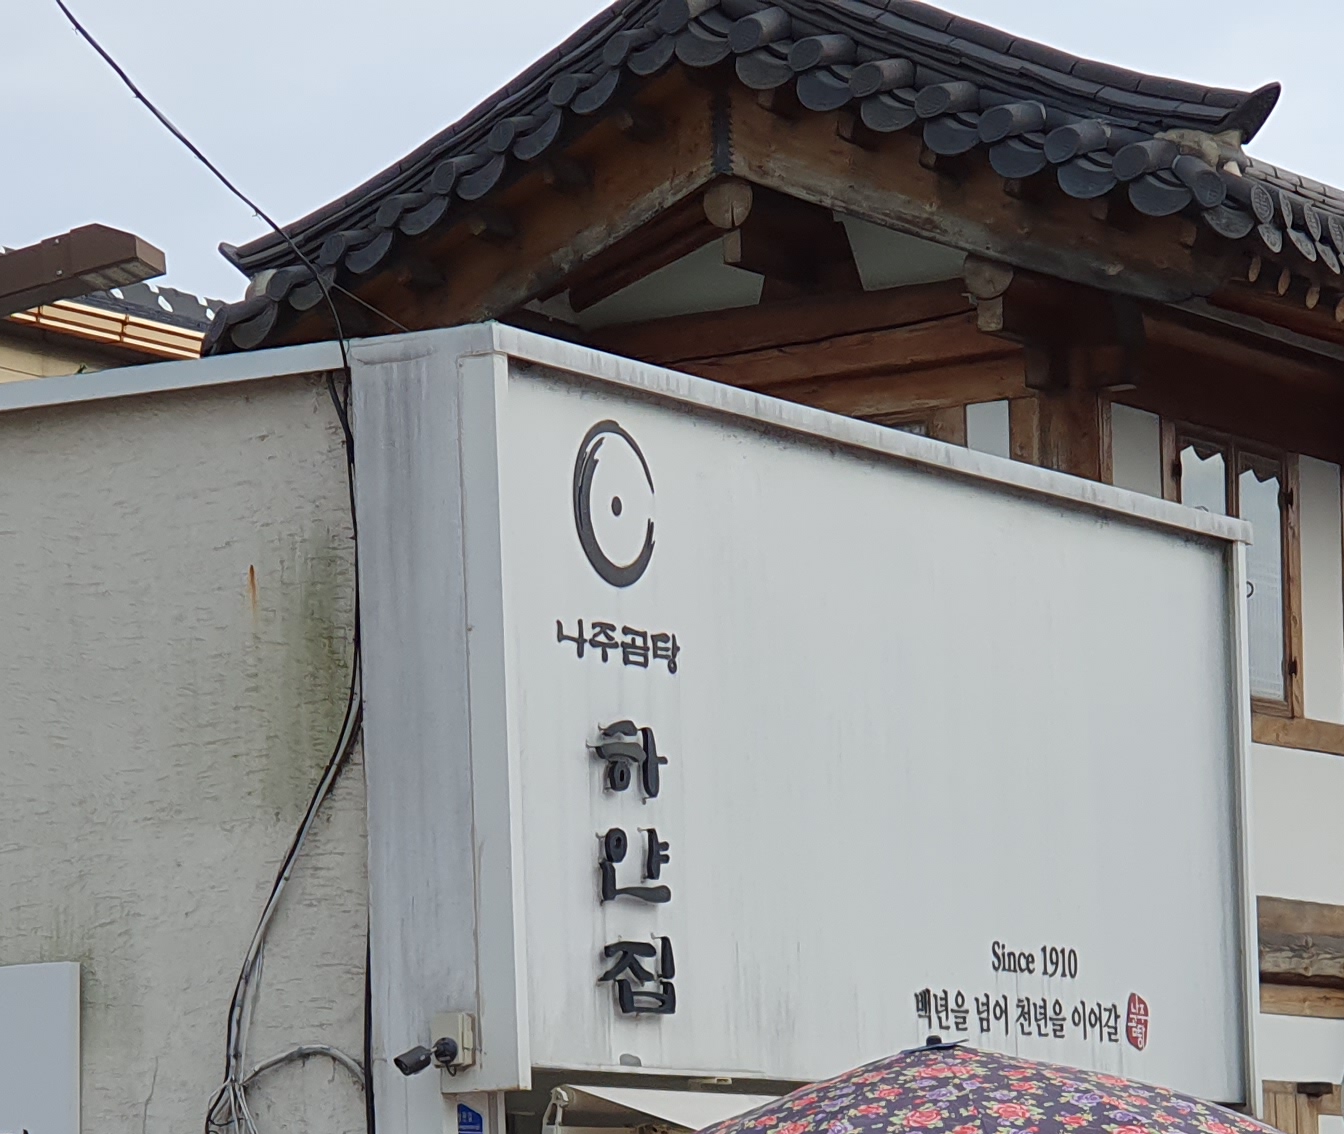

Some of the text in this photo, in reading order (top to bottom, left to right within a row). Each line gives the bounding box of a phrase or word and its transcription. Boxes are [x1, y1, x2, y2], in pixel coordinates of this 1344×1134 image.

[556, 618, 680, 674] 나주곰탕
[587, 720, 676, 1015] 하얀집
[991, 940, 1079, 979] Since 1910
[914, 987, 1121, 1043] 백년을 넘어 천년을 이어갈
